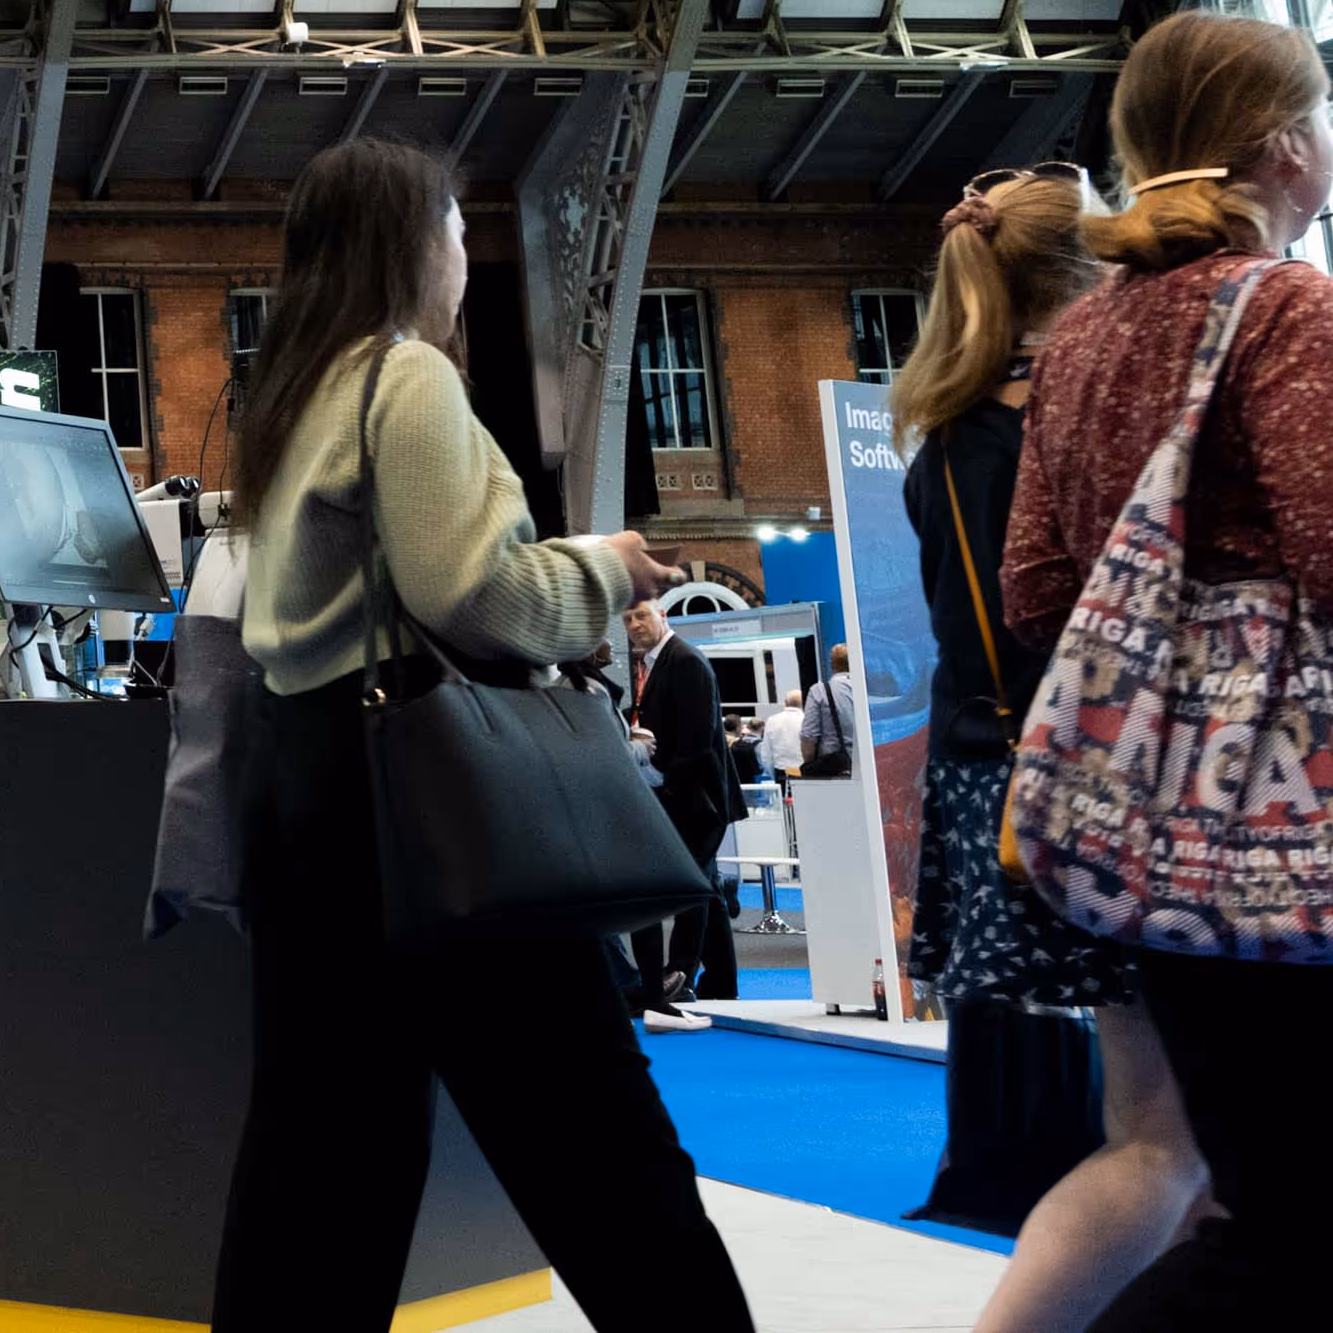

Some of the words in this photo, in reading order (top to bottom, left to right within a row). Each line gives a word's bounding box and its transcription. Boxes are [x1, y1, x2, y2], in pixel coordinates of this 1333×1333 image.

[849, 439, 907, 470] Softw
[1069, 605, 1147, 653] RIGA
[1197, 670, 1268, 698] RIGA
[1287, 845, 1333, 870] RIG
